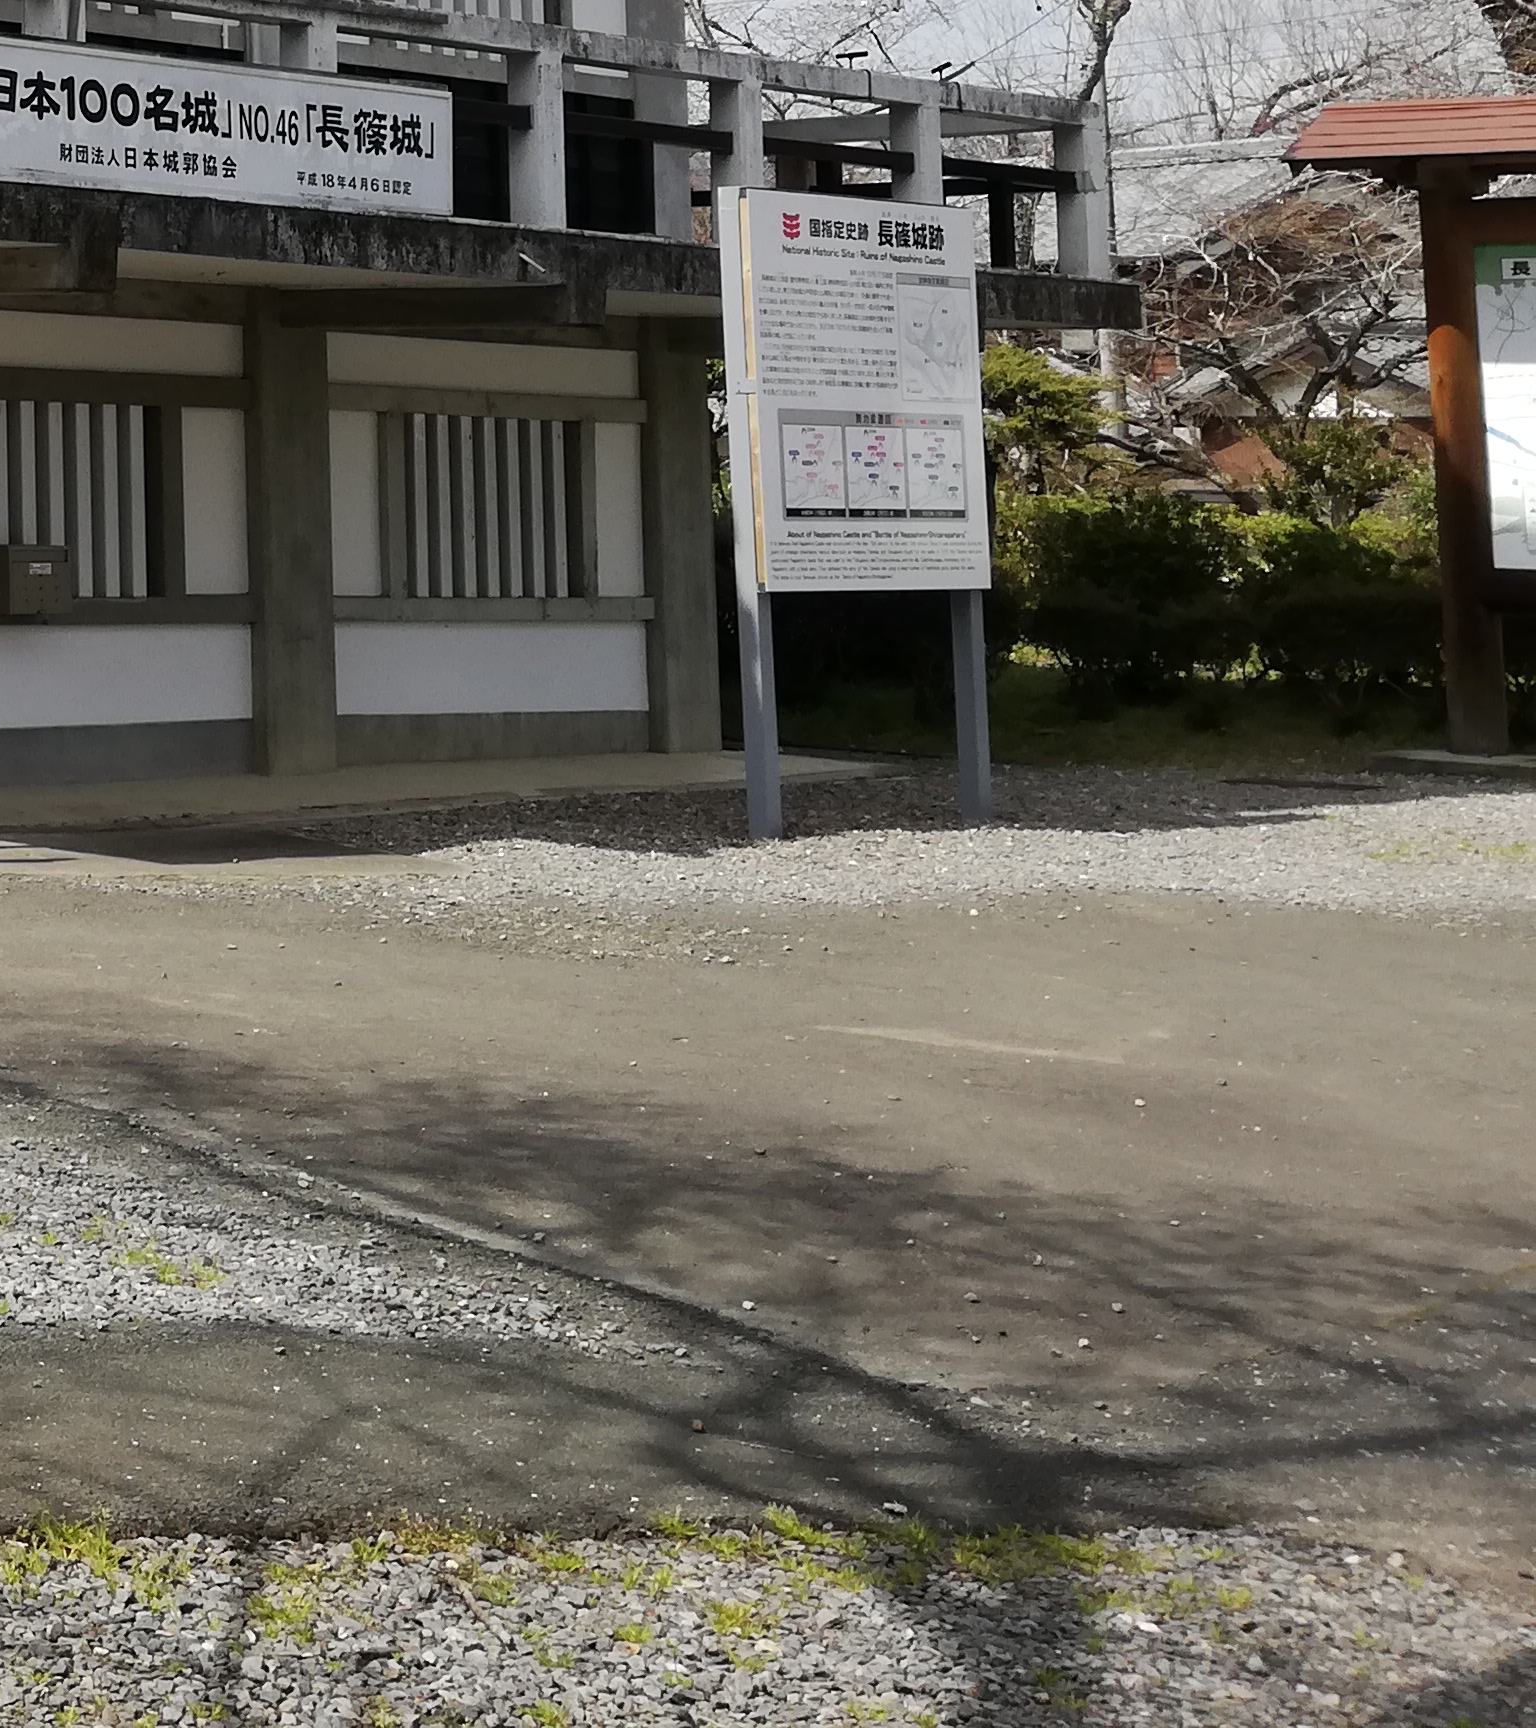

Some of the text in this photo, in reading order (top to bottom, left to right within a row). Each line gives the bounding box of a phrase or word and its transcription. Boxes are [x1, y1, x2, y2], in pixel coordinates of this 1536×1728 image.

[59, 143, 237, 179] 財団法人日本城郭協会
[296, 170, 413, 196] 平成18年4月6日認定
[878, 219, 945, 251] 長篠城跡
